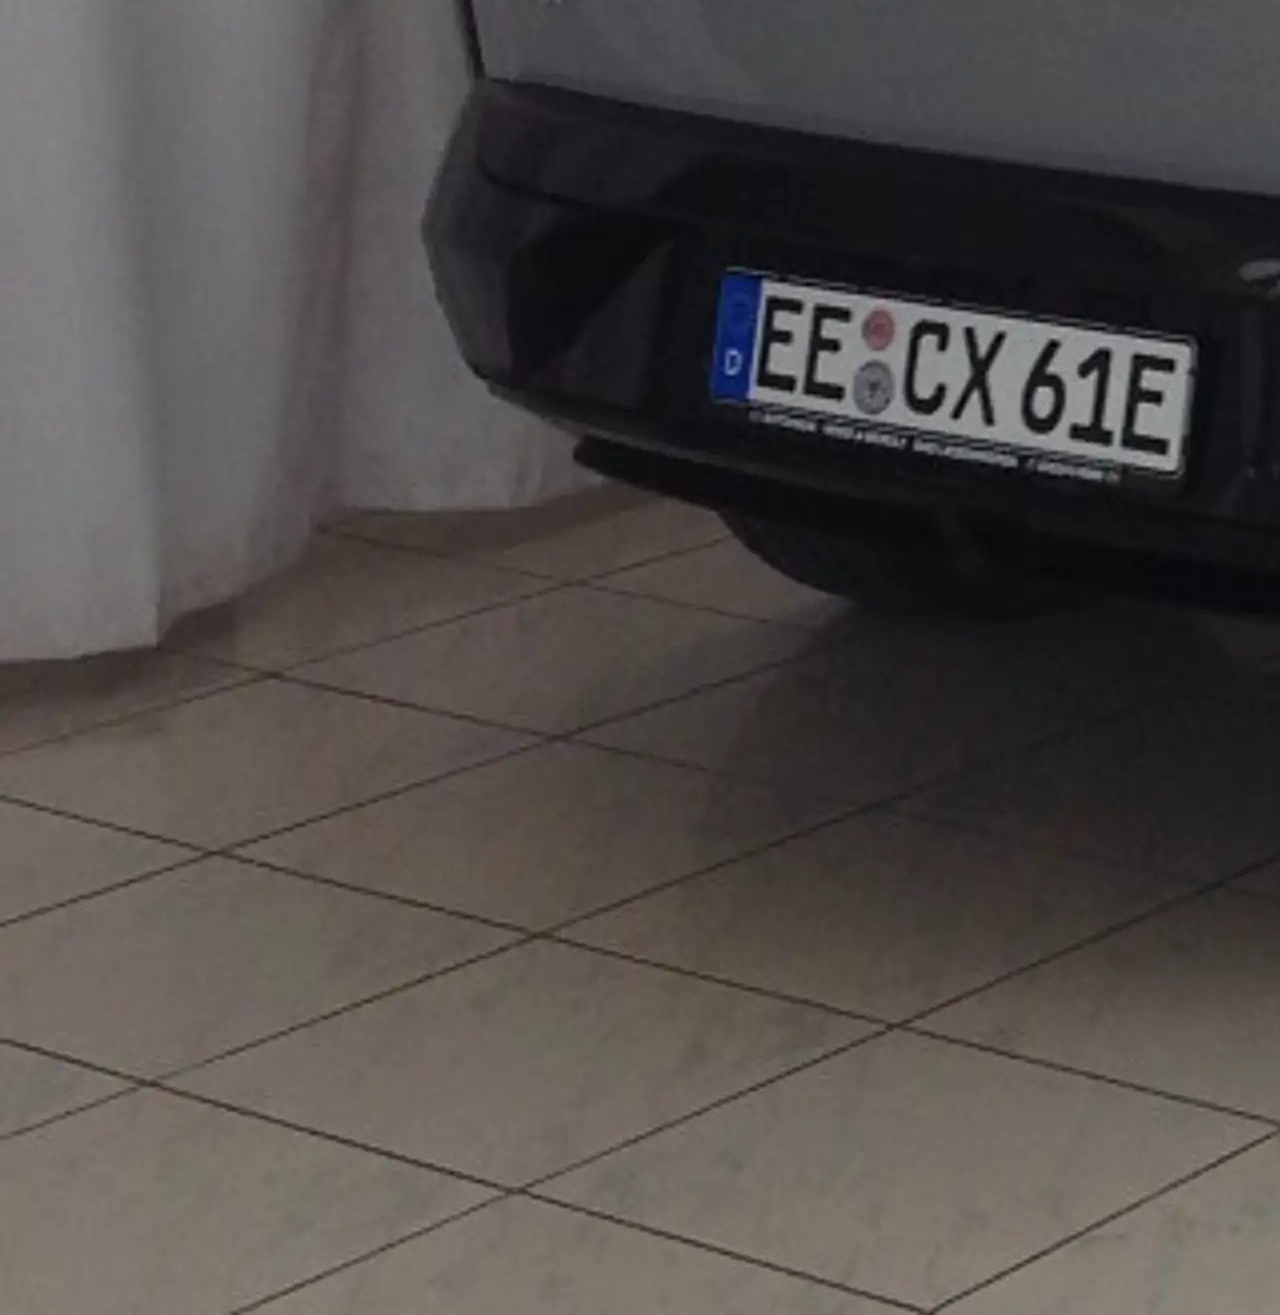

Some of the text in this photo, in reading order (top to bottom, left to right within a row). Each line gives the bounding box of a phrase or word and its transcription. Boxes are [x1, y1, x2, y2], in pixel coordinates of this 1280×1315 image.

[724, 348, 742, 376] D
[756, 295, 852, 401] EE
[903, 318, 1006, 427] CX
[1020, 338, 1176, 455] 61E
